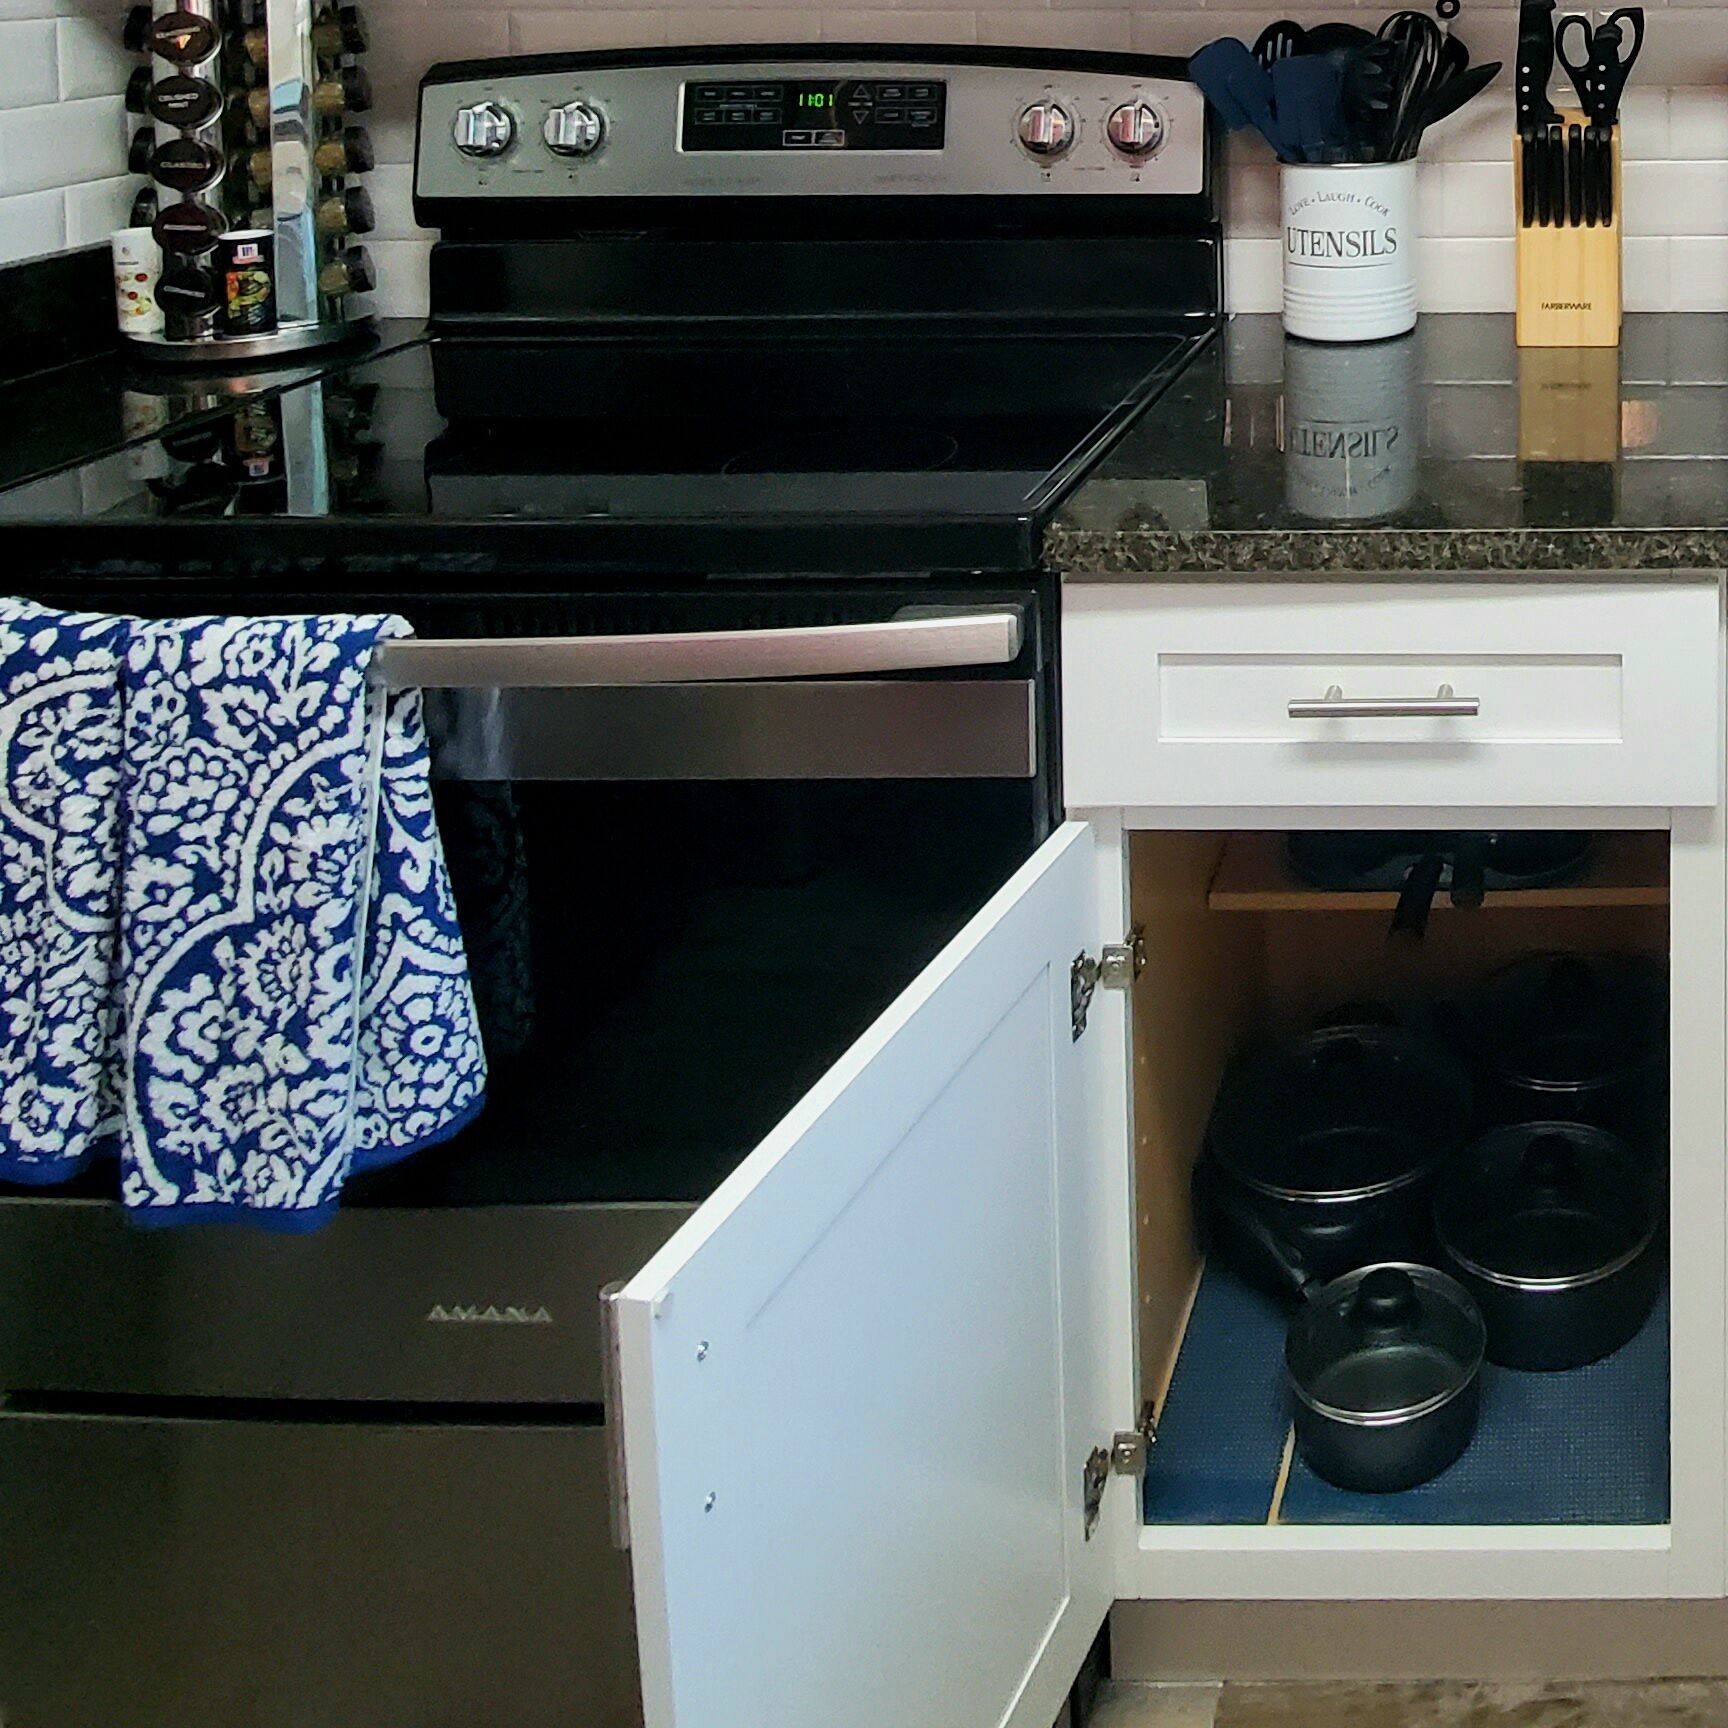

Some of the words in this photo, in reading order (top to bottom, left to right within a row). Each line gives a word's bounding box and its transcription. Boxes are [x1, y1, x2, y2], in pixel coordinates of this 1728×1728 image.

[799, 93, 833, 107] 11:01
[1316, 191, 1356, 203] LAUGH
[1364, 195, 1390, 217] COOK
[1287, 226, 1397, 258] UTENSILS
[1541, 301, 1593, 311] FARBERWARE
